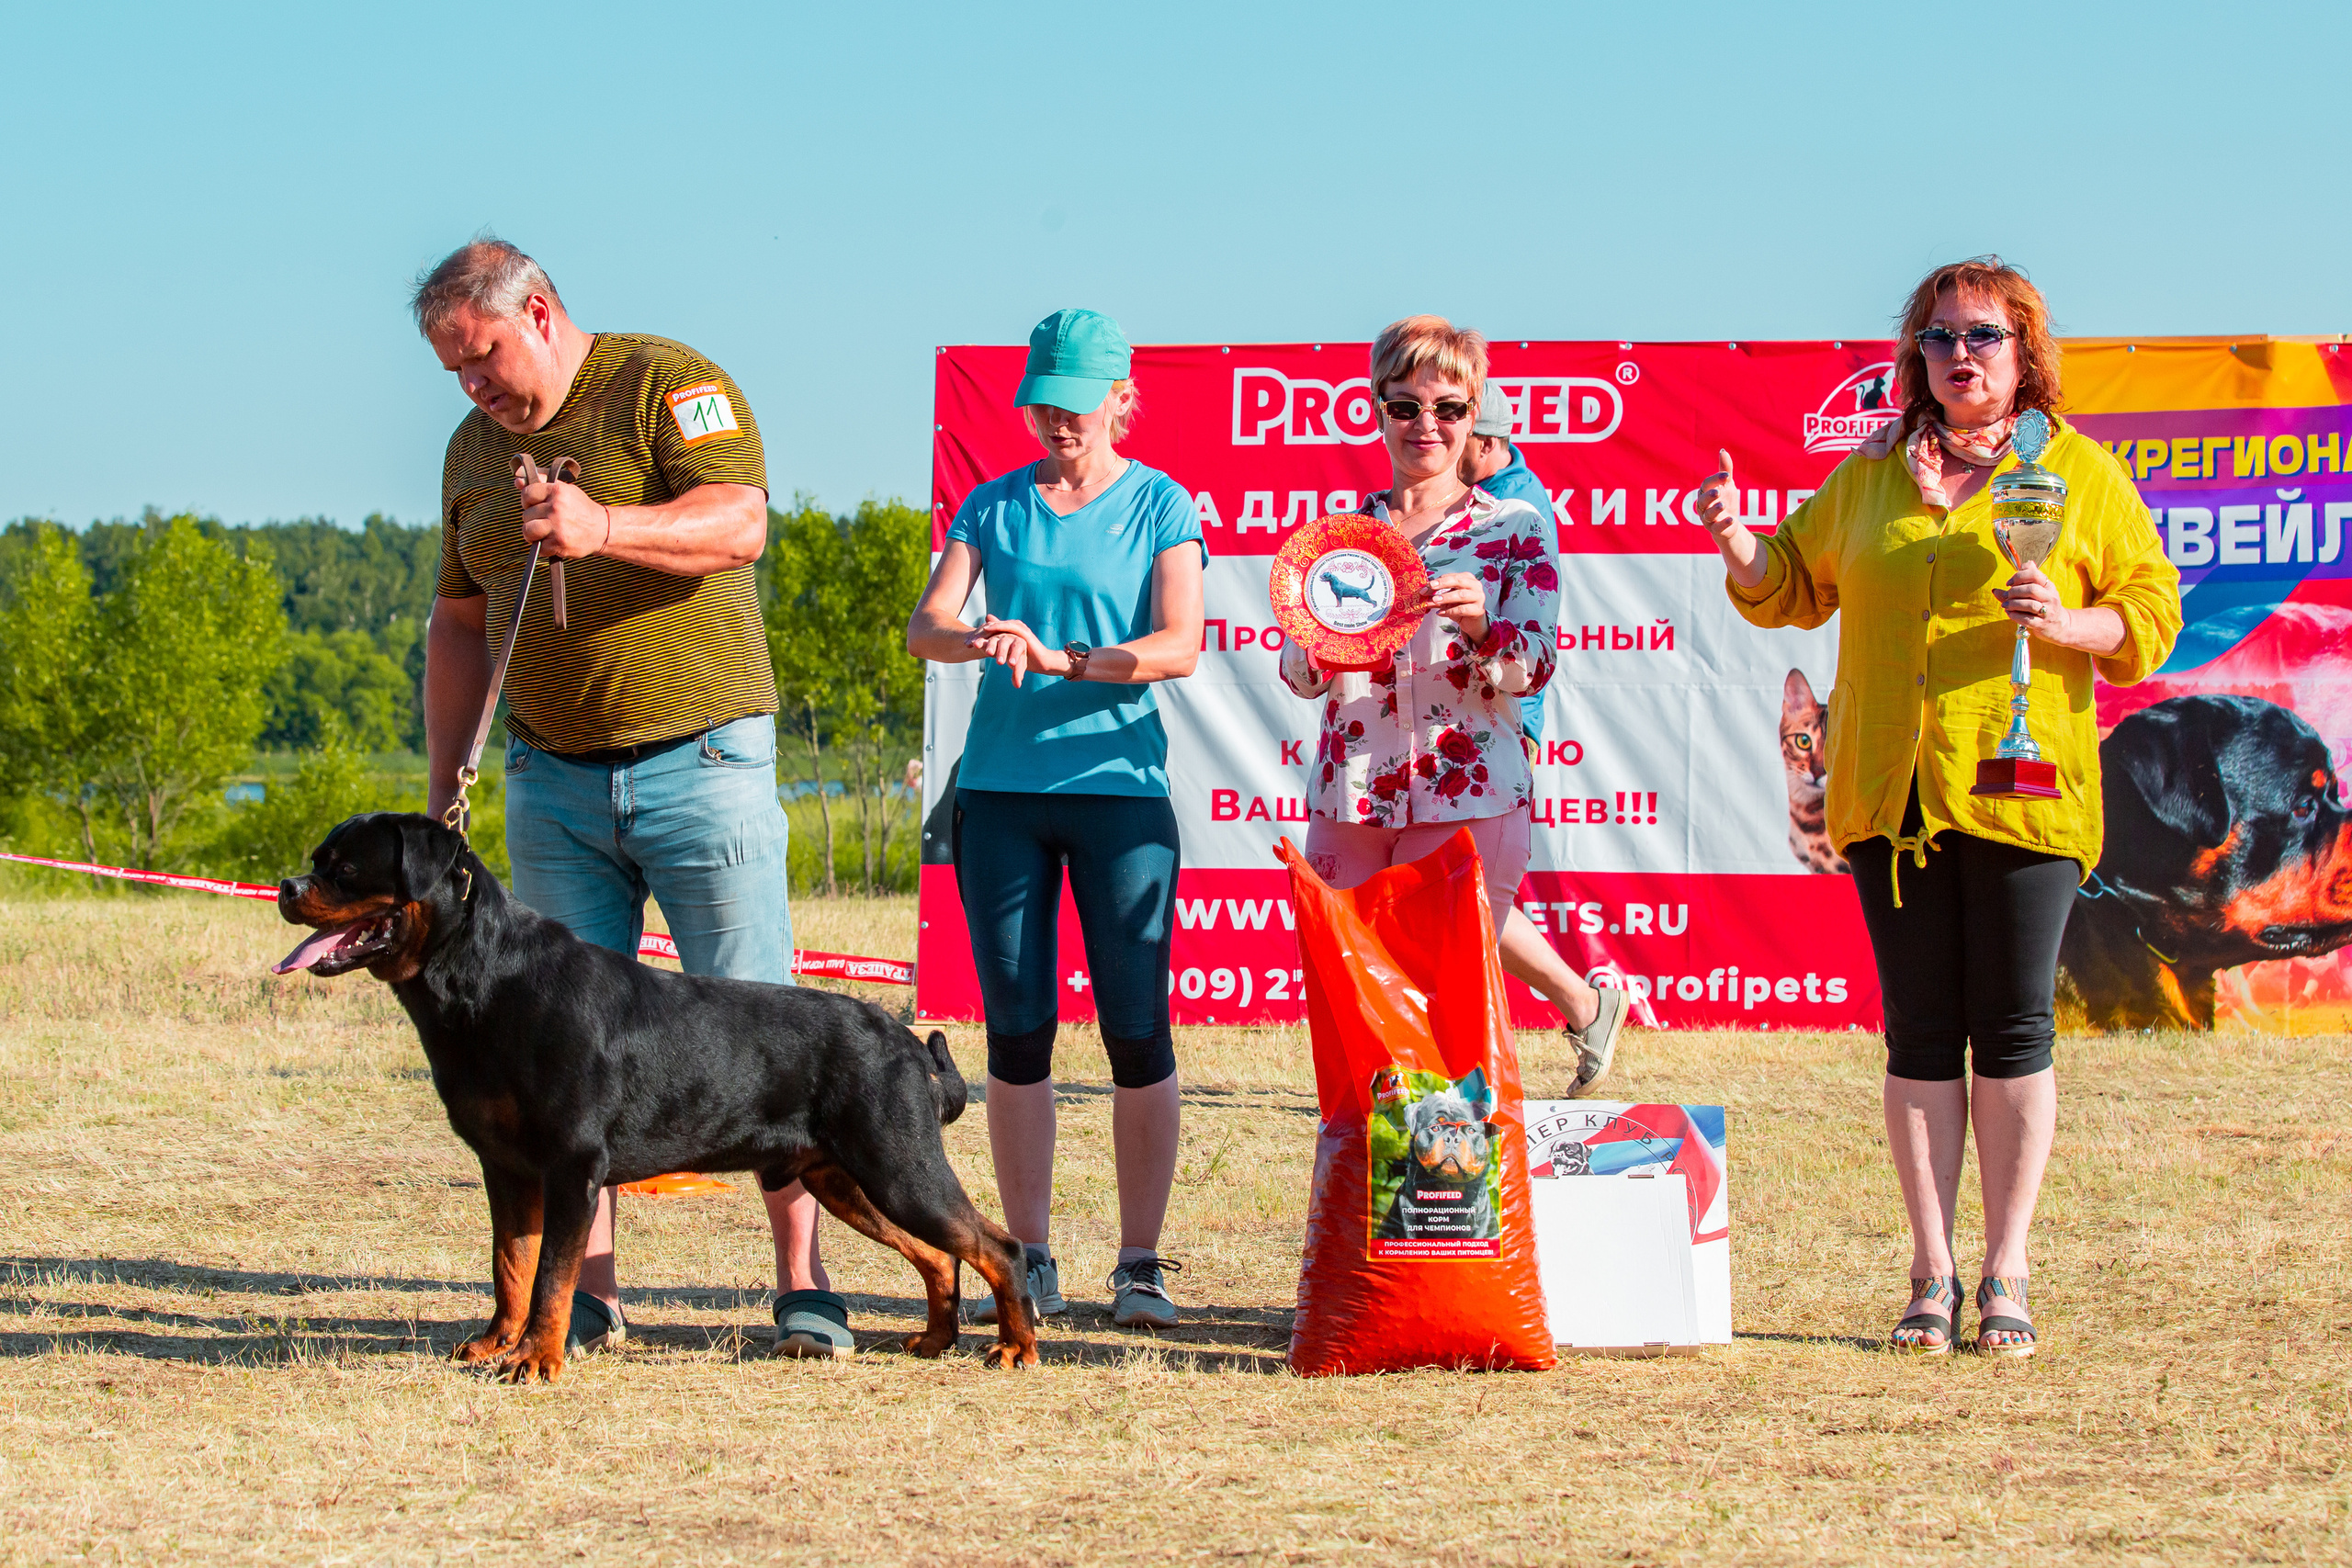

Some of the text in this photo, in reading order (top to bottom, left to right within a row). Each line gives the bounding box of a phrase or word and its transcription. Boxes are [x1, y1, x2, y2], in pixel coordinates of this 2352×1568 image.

[694, 396, 724, 432] 11
[1237, 490, 1357, 534] ДЛЯ
[1591, 489, 1626, 525] И
[1281, 739, 1304, 765] К
[848, 964, 910, 981] ТРАПЕЗА
[1585, 1114, 1654, 1145] КЛУБ
[1417, 1190, 1462, 1199] PROFIFEED
